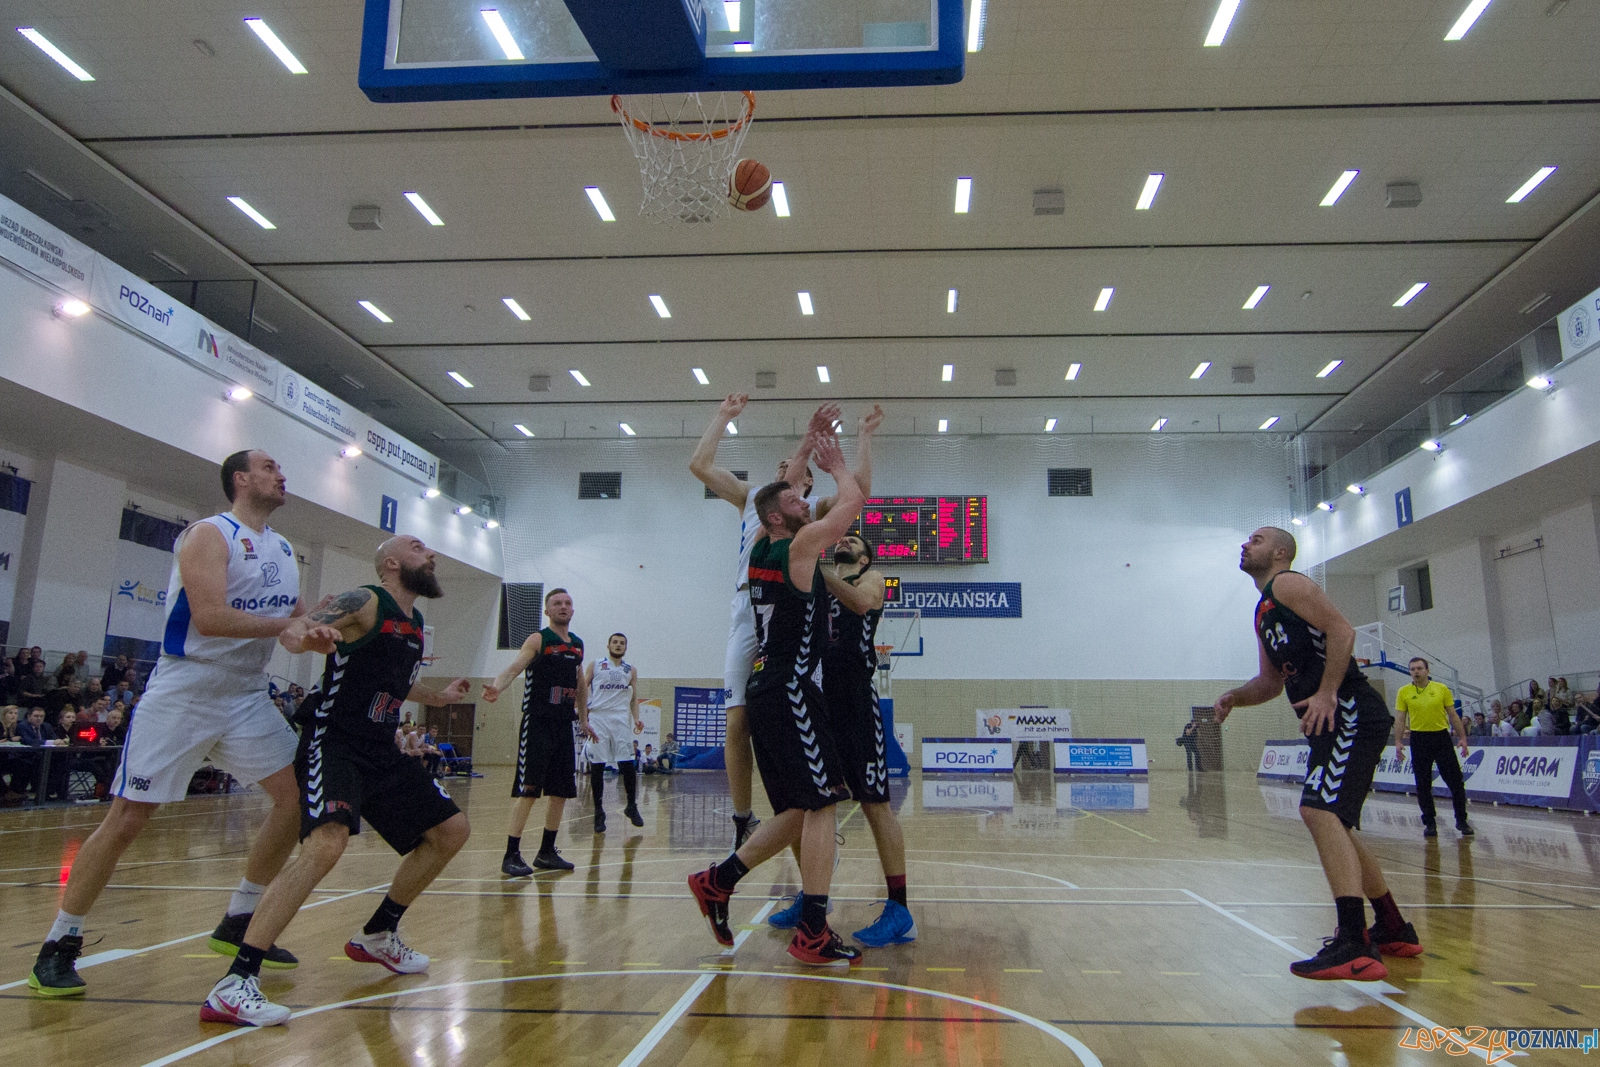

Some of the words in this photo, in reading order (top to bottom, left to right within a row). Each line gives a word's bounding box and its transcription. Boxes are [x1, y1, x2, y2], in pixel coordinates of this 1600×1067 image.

[20, 225, 64, 258] MARSZAŁKOWSKI
[40, 249, 85, 281] WIELKOPOLSKIEGO
[302, 401, 330, 426] Politechniki
[304, 386, 326, 407] Centrum
[325, 398, 341, 416] Sportu
[386, 501, 393, 529] 1
[865, 511, 882, 524] 52
[901, 511, 918, 524] 43
[1399, 494, 1408, 523] 1
[261, 561, 281, 588] 12
[904, 589, 1009, 608] POZNAŃSKA
[1265, 621, 1289, 651] 24
[1016, 714, 1057, 725] MAXXX
[1070, 747, 1106, 755] ORLICO
[866, 762, 876, 786] 5
[1496, 755, 1560, 777] BIOFARM
[131, 776, 151, 791] PBG
